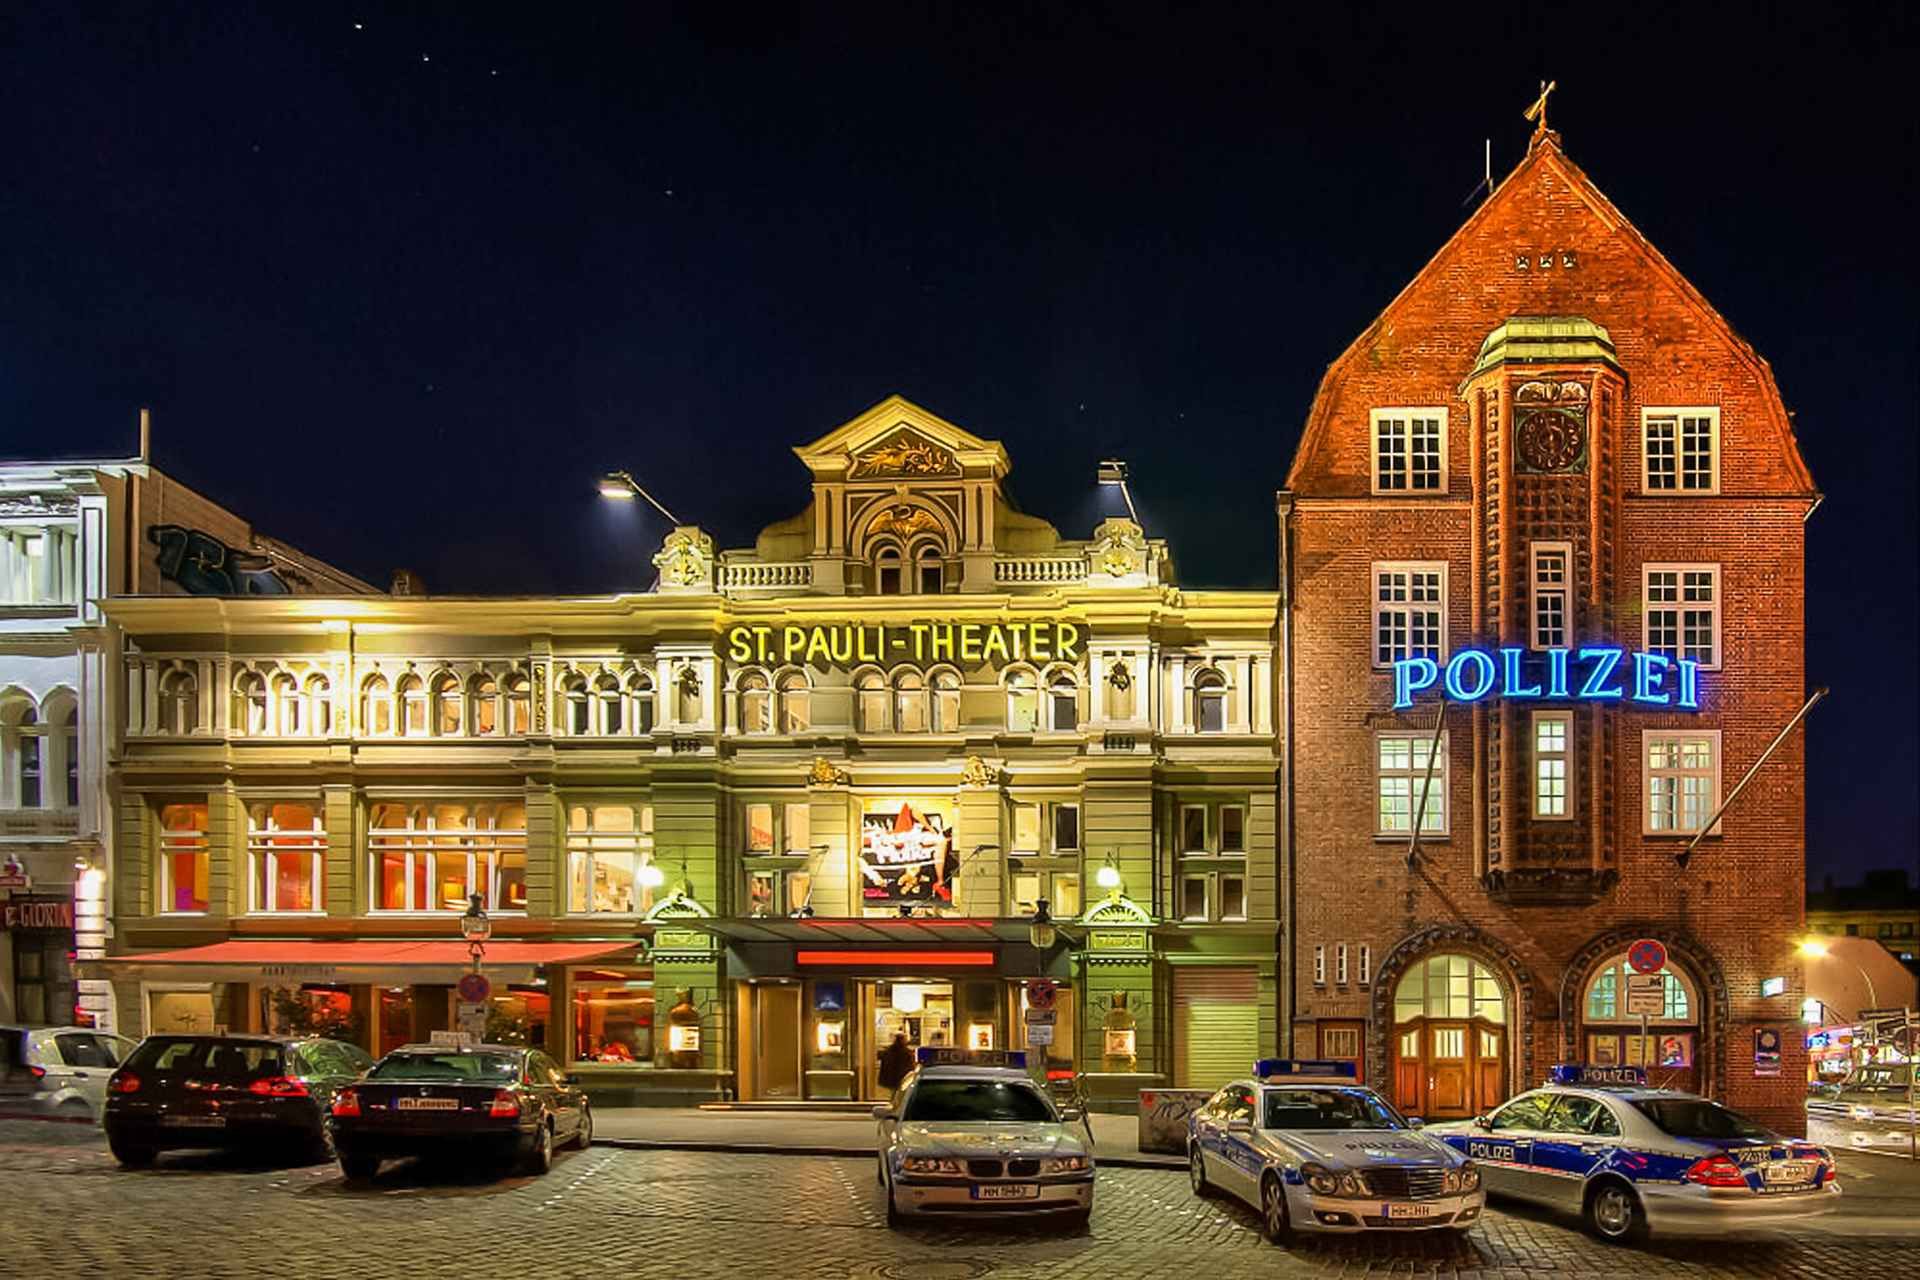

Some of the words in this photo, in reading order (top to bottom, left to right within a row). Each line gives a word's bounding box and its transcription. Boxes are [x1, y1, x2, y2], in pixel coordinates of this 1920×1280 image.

[728, 625, 776, 663] ST.
[1391, 647, 1699, 710] POLIZEI
[936, 1050, 1010, 1064] POLZEI
[1583, 1069, 1638, 1084] POLIZEI
[1470, 1142, 1515, 1160] POLIZEI
